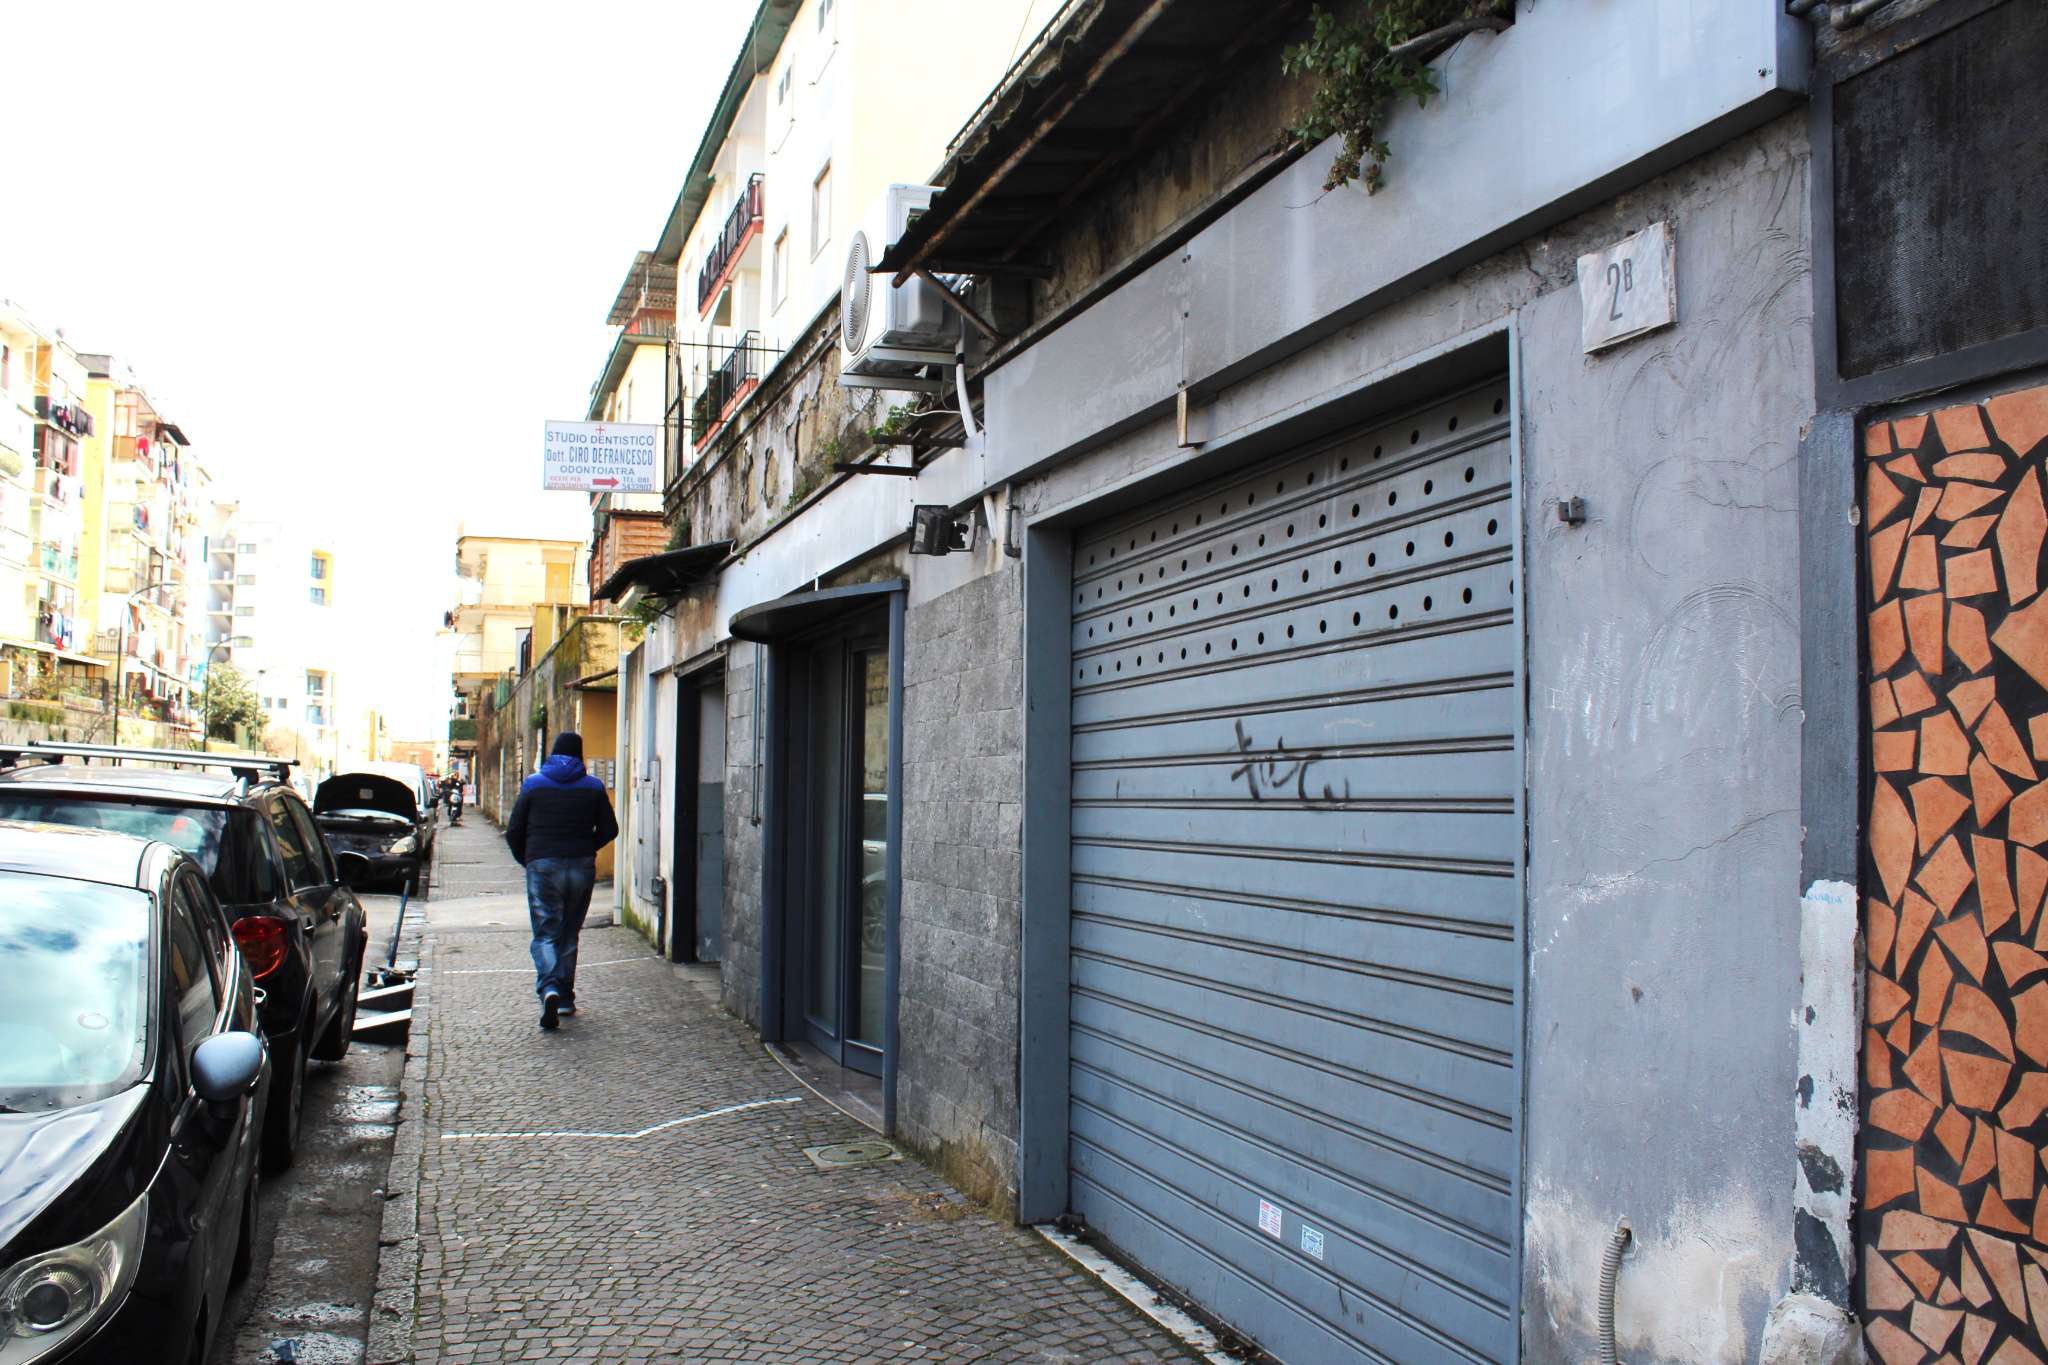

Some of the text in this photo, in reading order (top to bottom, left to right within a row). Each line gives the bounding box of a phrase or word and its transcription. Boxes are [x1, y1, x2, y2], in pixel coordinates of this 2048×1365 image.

[547, 431, 655, 447] STUDIO DENTISTICO
[569, 446, 589, 463] CIRO
[592, 447, 653, 466] DEFRANCESCO
[560, 465, 636, 475] ODONTOIATRA
